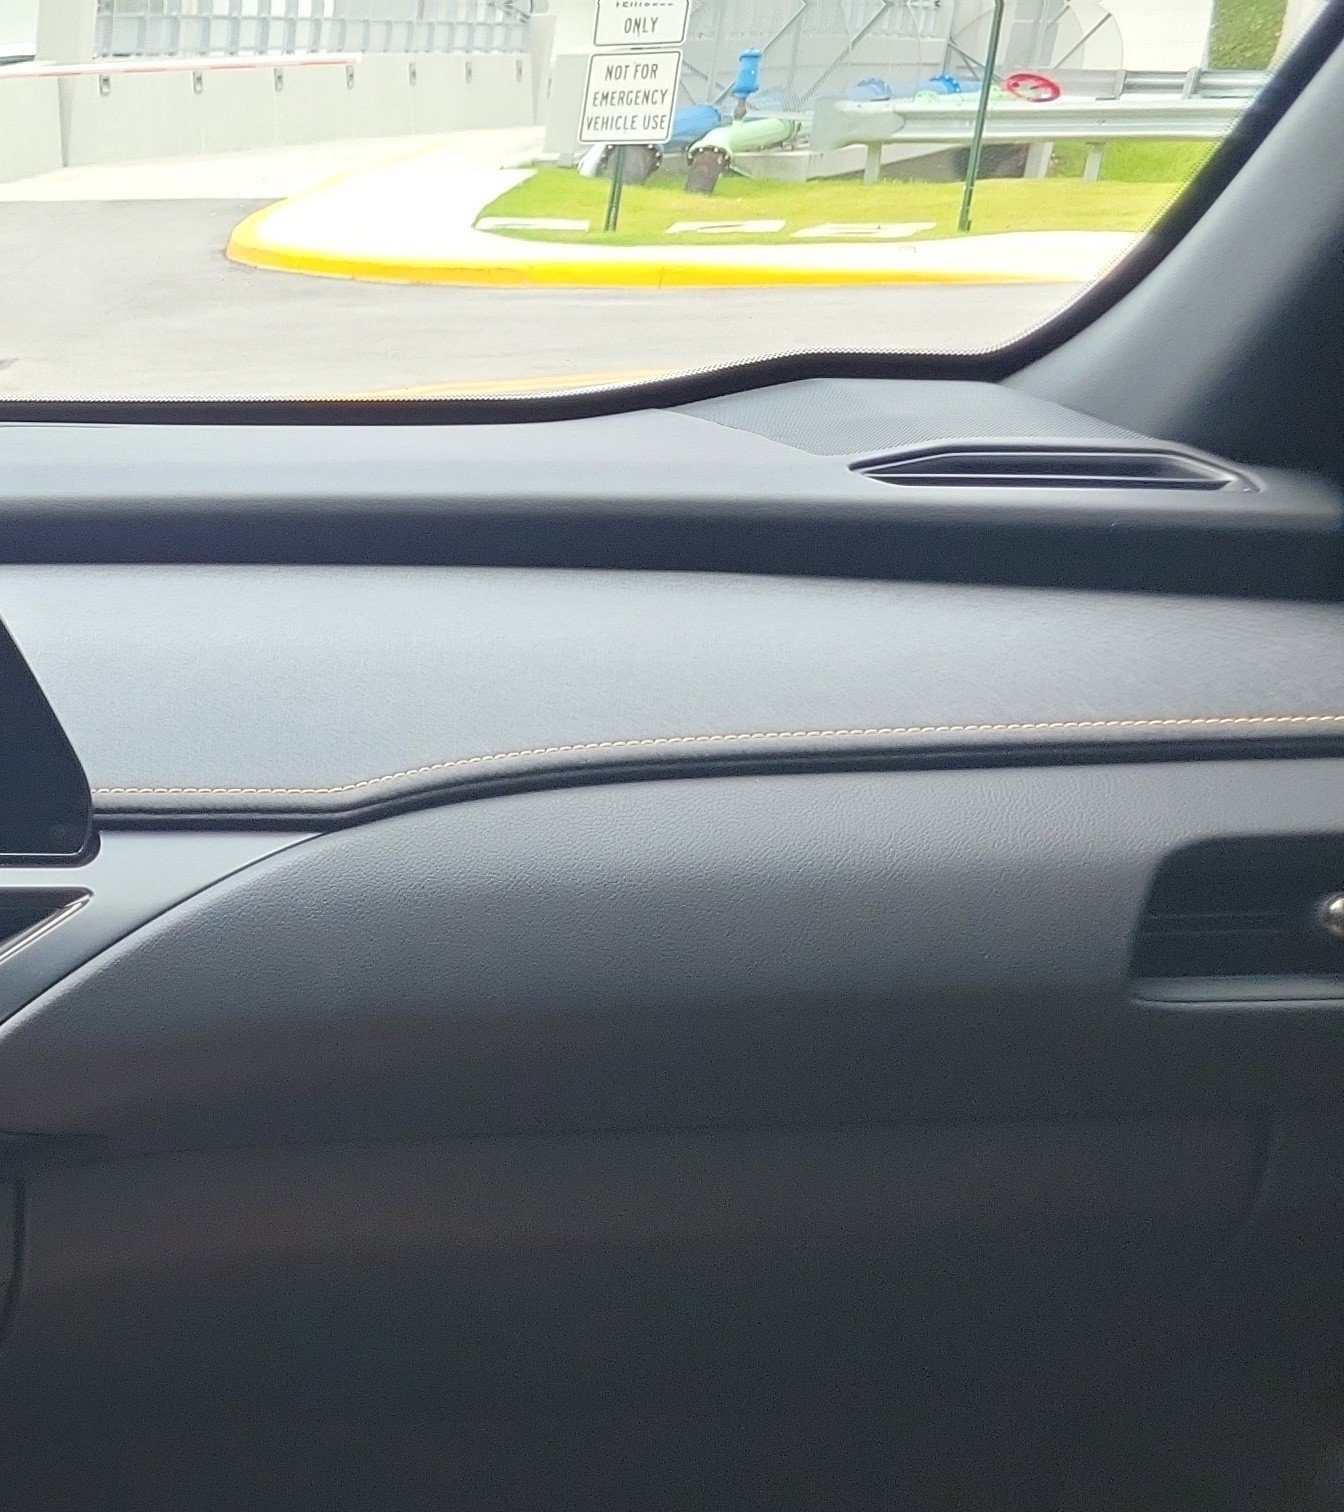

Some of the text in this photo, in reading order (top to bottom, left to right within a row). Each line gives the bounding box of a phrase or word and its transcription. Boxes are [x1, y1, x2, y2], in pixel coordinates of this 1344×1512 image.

[624, 17, 659, 35] ONLY
[605, 63, 659, 81] NOT FOR
[592, 89, 669, 107] EMERGENCY
[586, 114, 667, 131] VEHICLE USE
